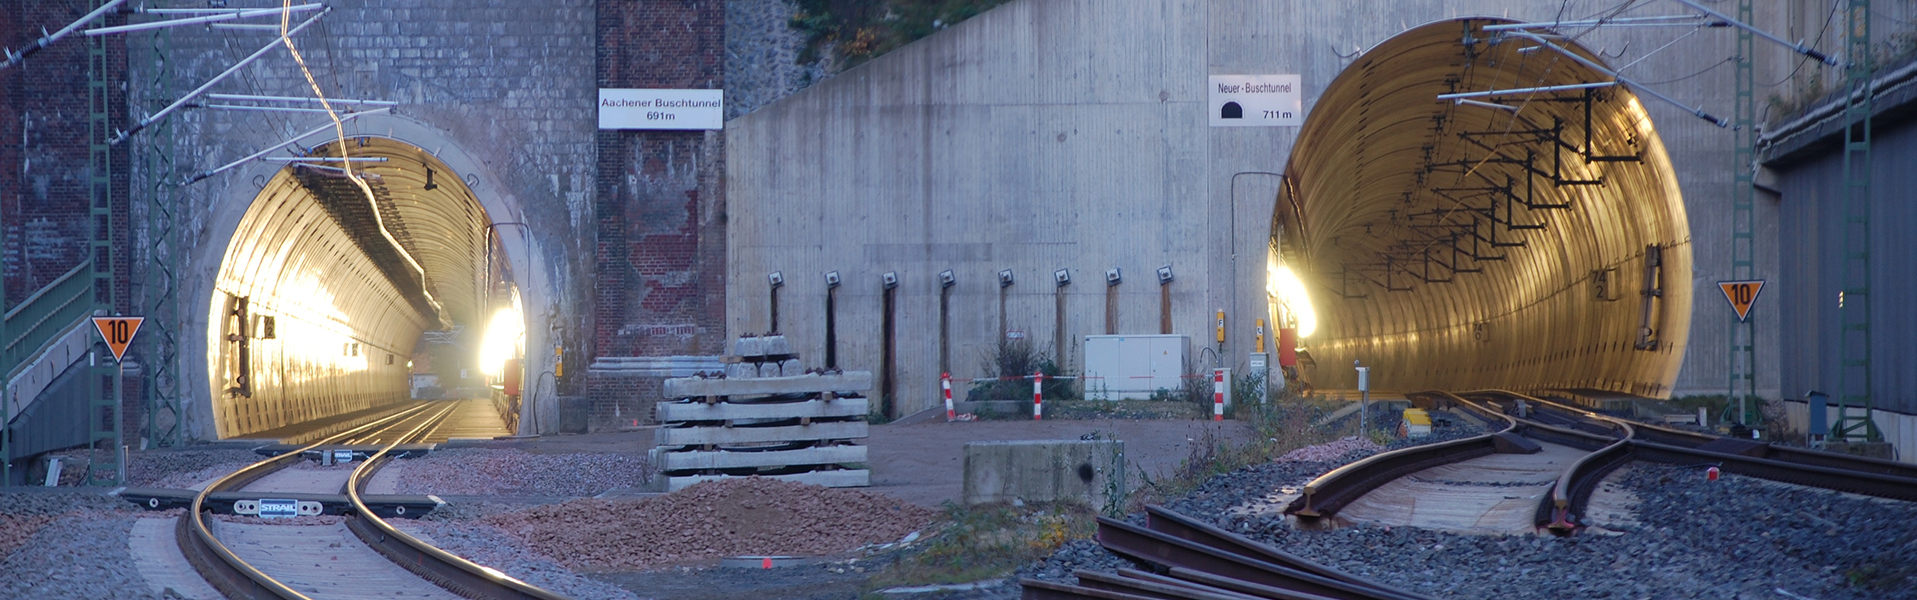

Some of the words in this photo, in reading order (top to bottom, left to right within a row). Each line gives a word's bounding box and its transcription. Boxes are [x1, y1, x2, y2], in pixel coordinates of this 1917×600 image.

[1218, 82, 1240, 93] Neuer
[1245, 82, 1291, 93] Buschtunnel
[601, 98, 652, 107] Aachener
[655, 98, 721, 107] Buschtunnel
[646, 111, 675, 120] 691m
[1263, 110, 1279, 119] 711
[1592, 271, 1607, 284] 74
[1596, 285, 1604, 298] 2
[1732, 283, 1751, 305] 10
[108, 319, 129, 345] 10
[267, 327, 273, 336] 2
